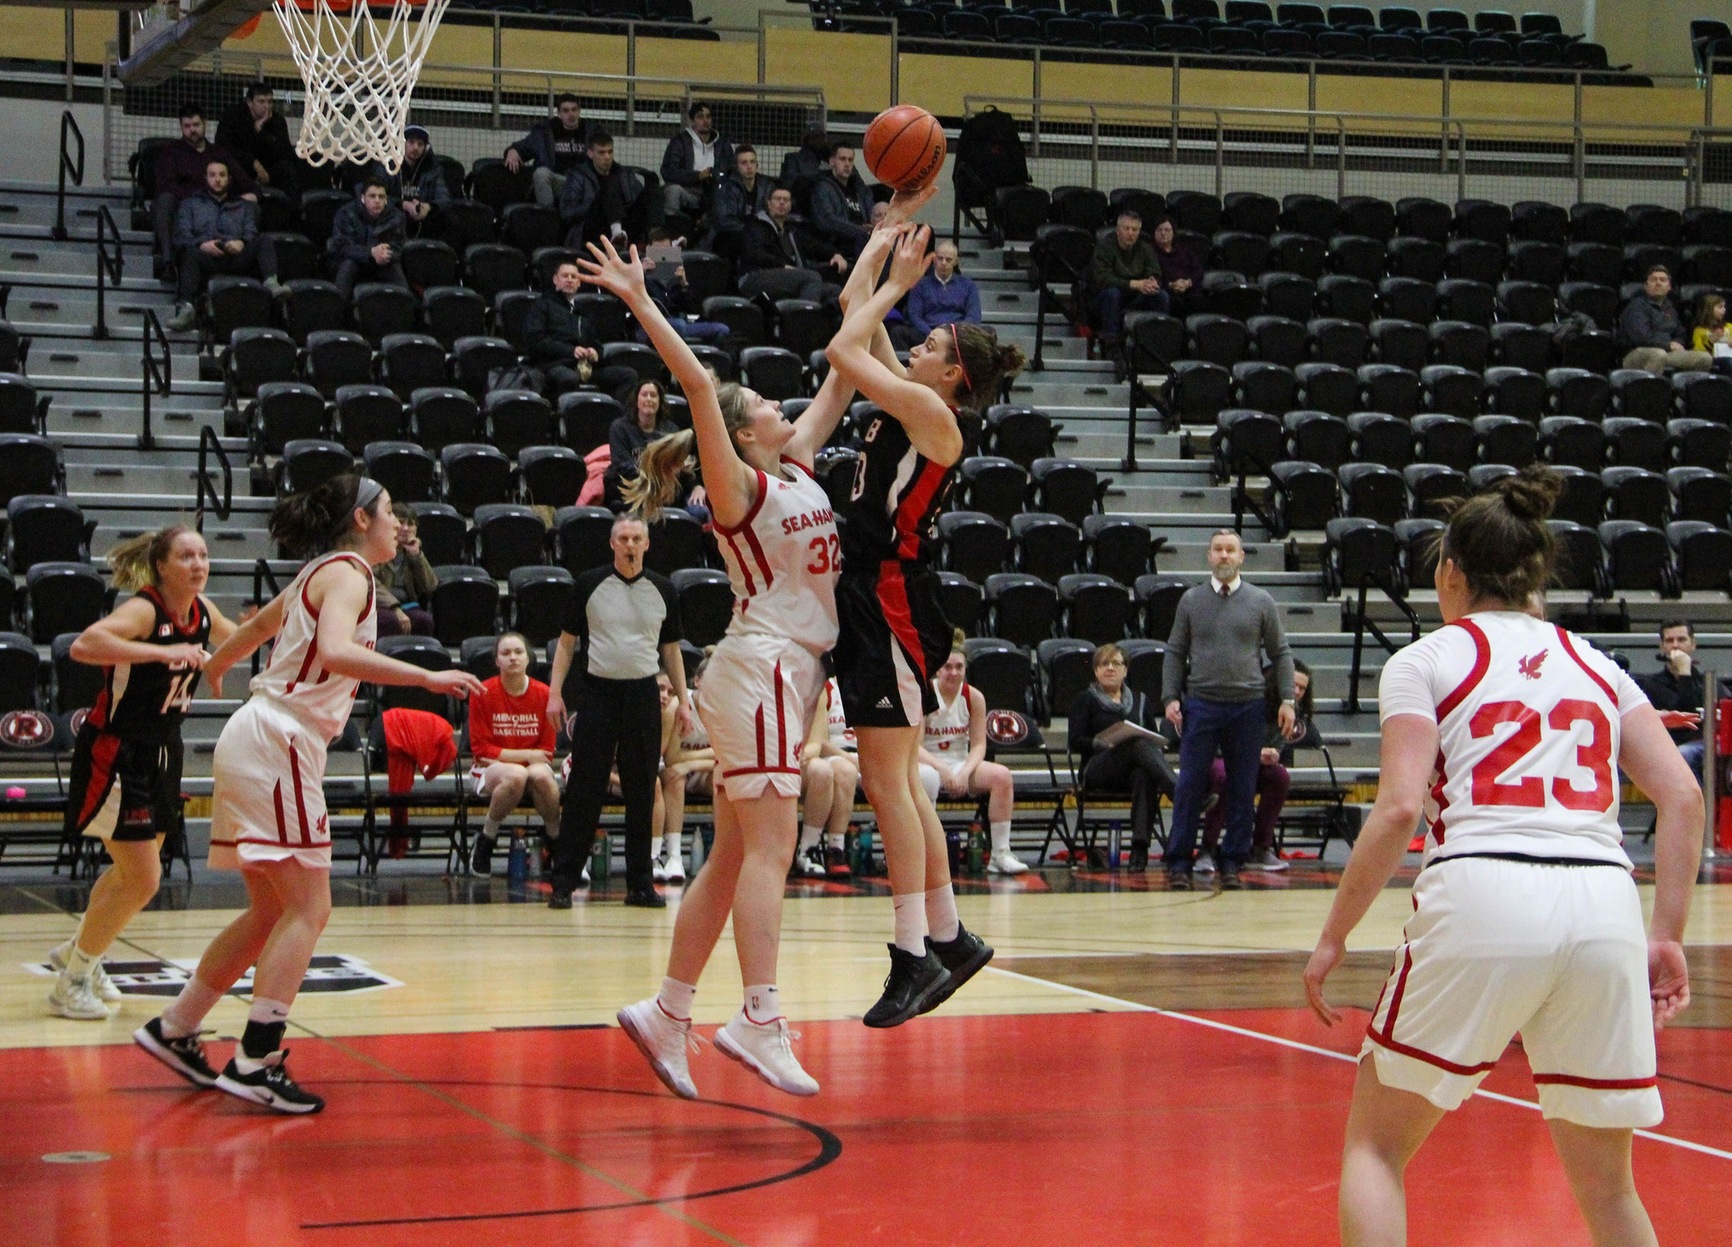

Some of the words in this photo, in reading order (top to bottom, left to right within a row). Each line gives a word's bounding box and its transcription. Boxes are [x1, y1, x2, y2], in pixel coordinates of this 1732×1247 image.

[807, 533, 840, 574] 32
[160, 672, 192, 714] 14
[492, 713, 539, 723] MEMORIAL
[493, 728, 539, 736] BASKETBALL
[1469, 698, 1614, 813] 23
